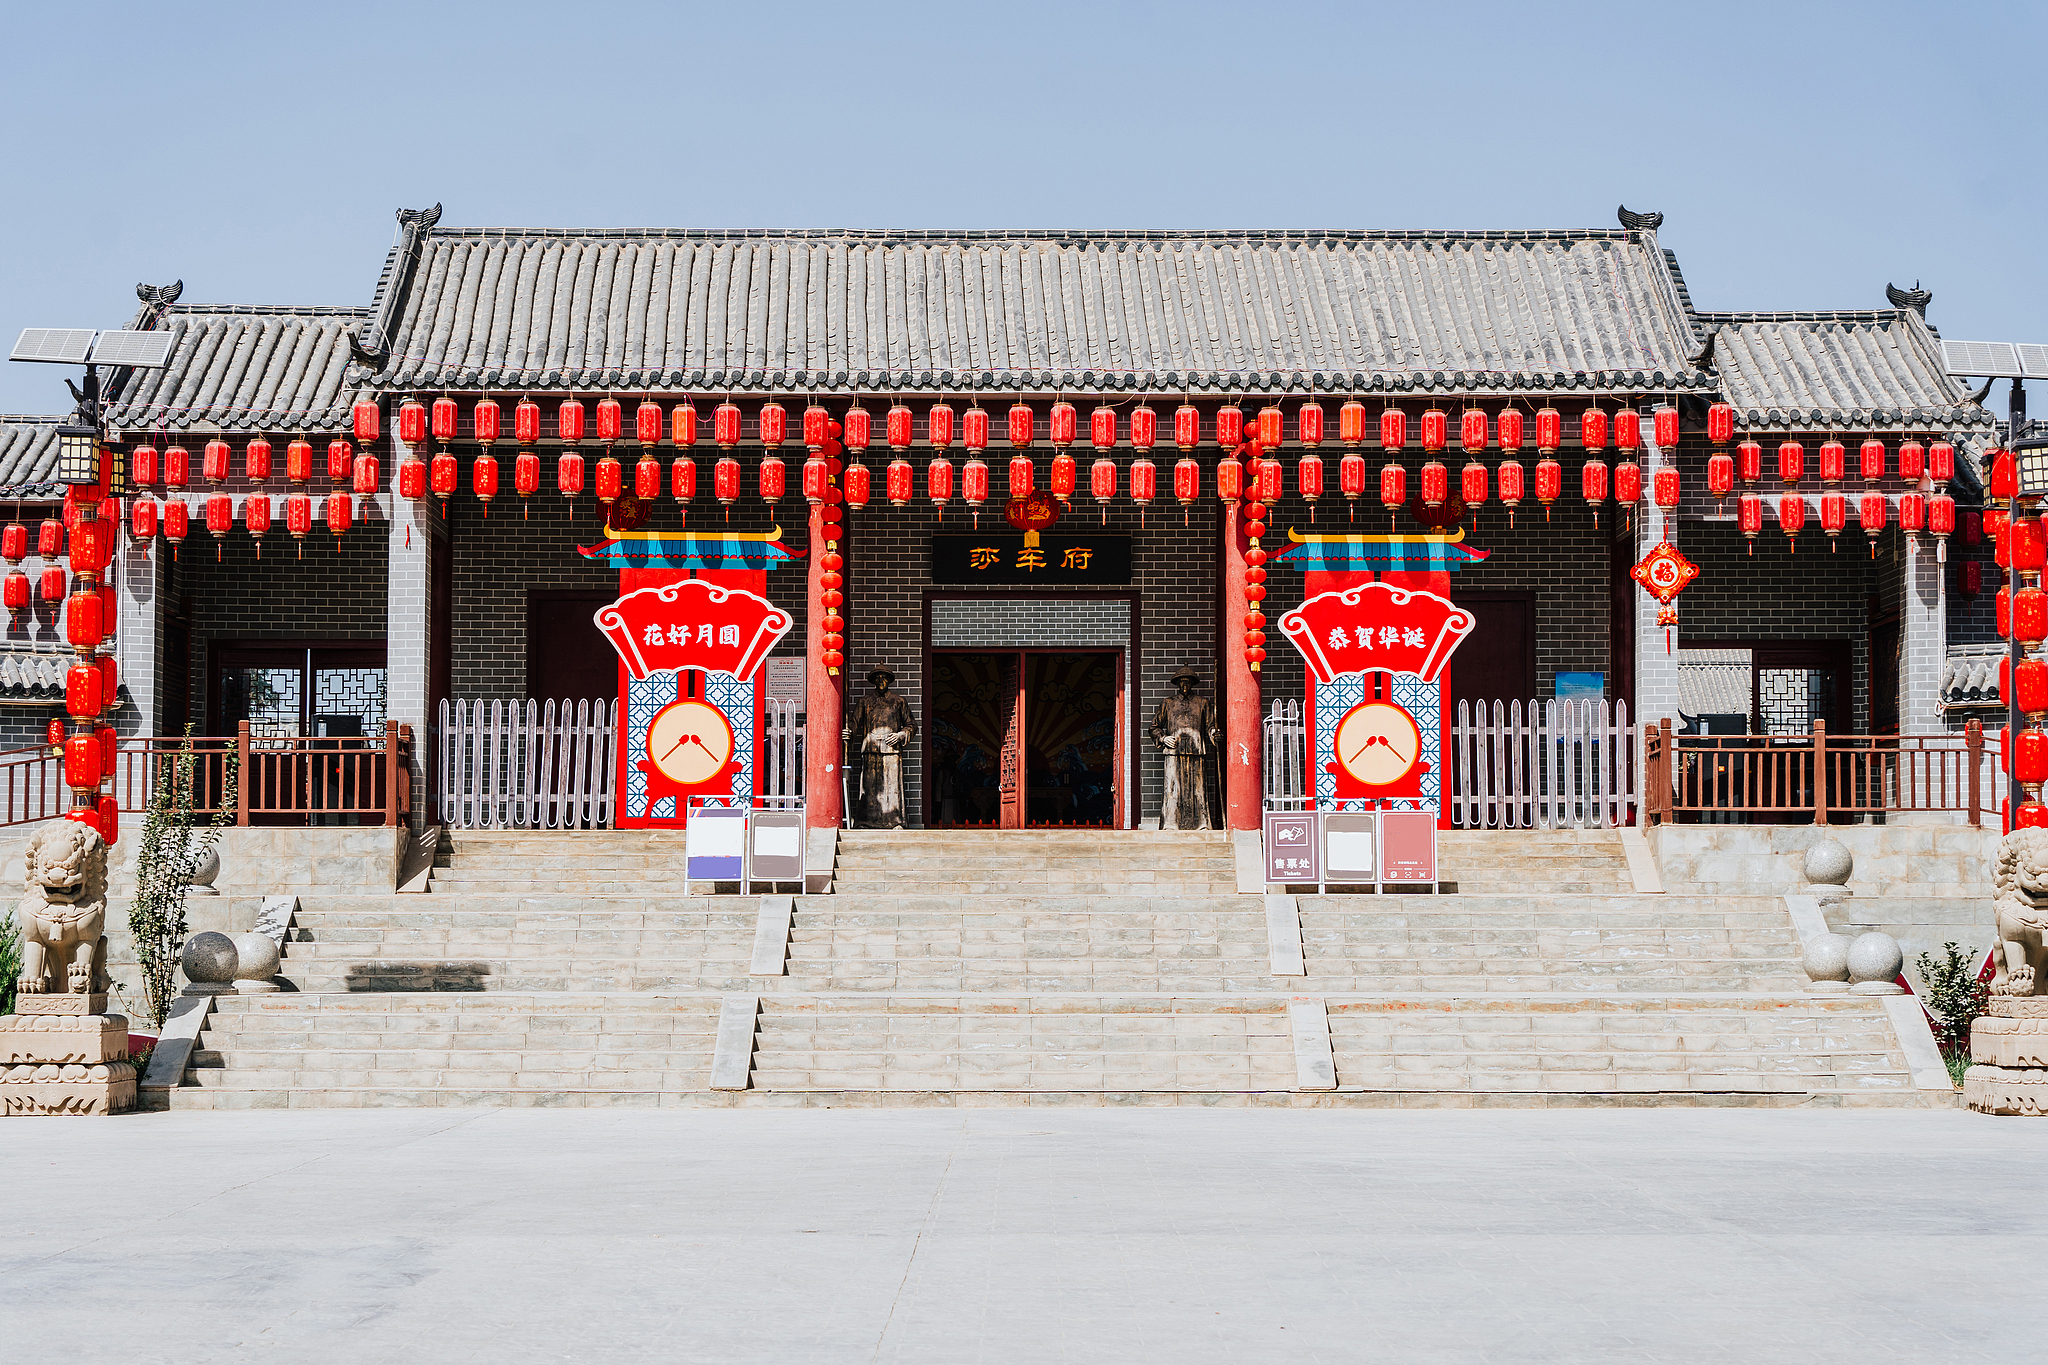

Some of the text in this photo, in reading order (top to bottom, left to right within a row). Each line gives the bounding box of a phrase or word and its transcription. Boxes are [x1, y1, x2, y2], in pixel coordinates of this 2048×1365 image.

[969, 546, 1094, 572] 莎车府
[1655, 562, 1675, 582] 福
[643, 623, 740, 648] 花好月圓
[1274, 857, 1311, 870] 售票处
